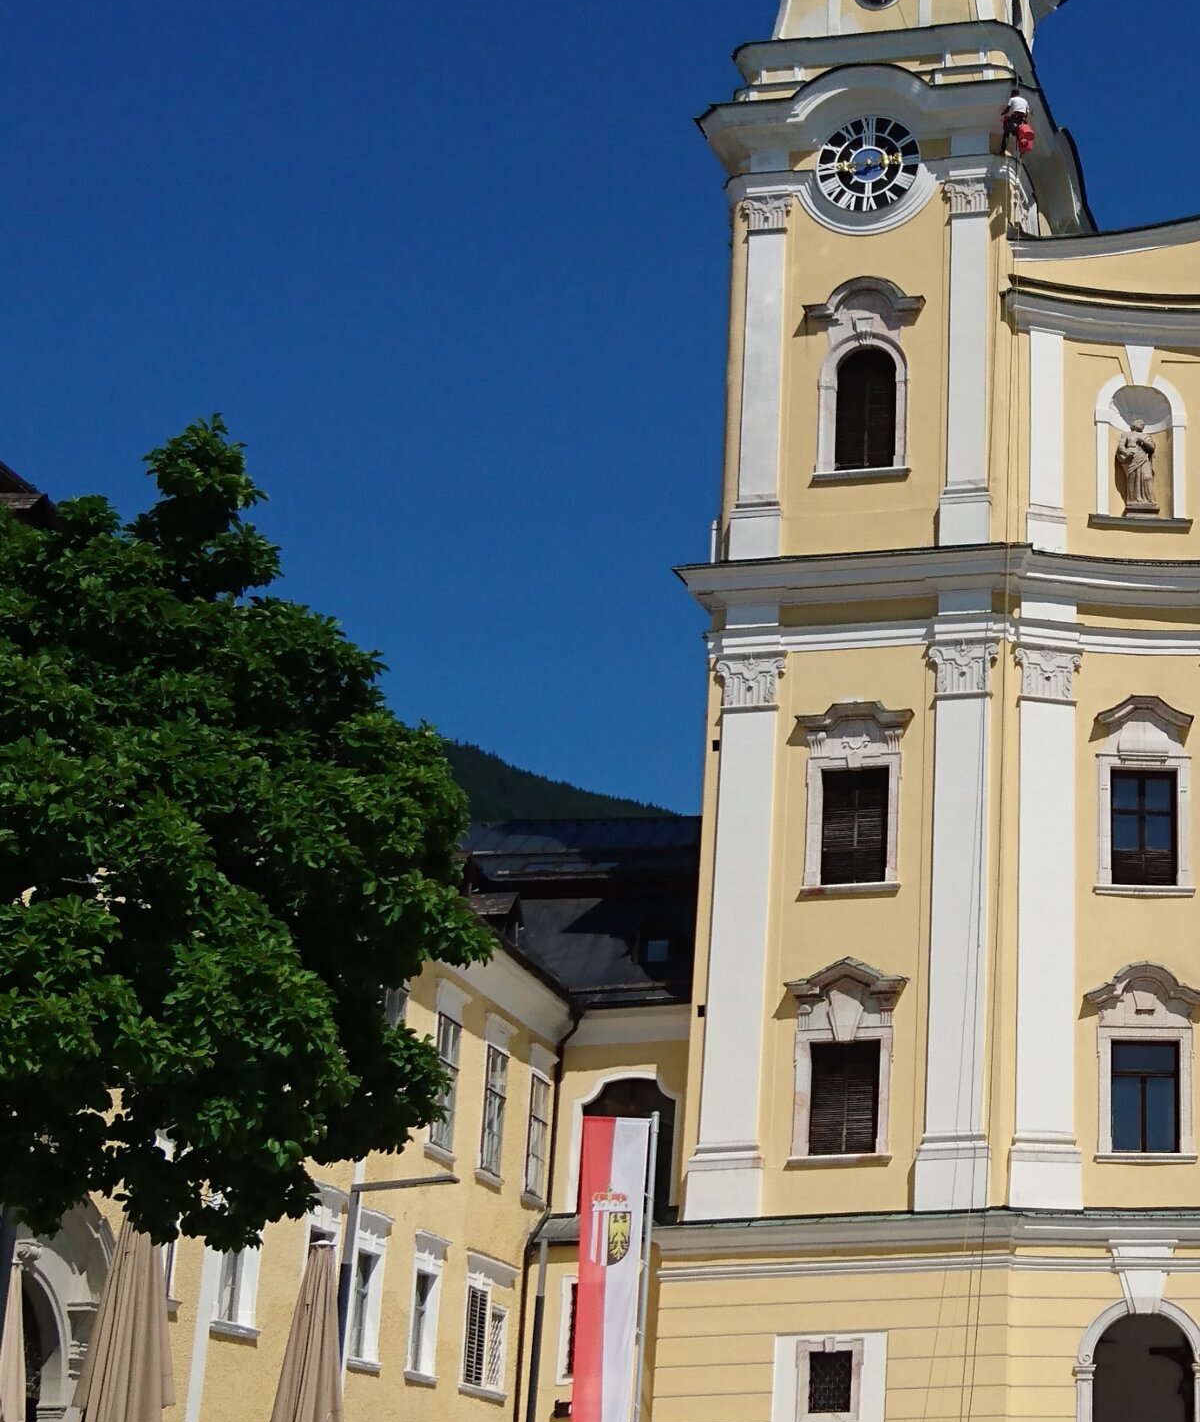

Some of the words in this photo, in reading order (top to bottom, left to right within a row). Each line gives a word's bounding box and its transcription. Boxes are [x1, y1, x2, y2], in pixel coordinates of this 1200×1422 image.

[861, 117, 877, 134] XII
[862, 196, 878, 211] VI
[885, 190, 899, 204] V
